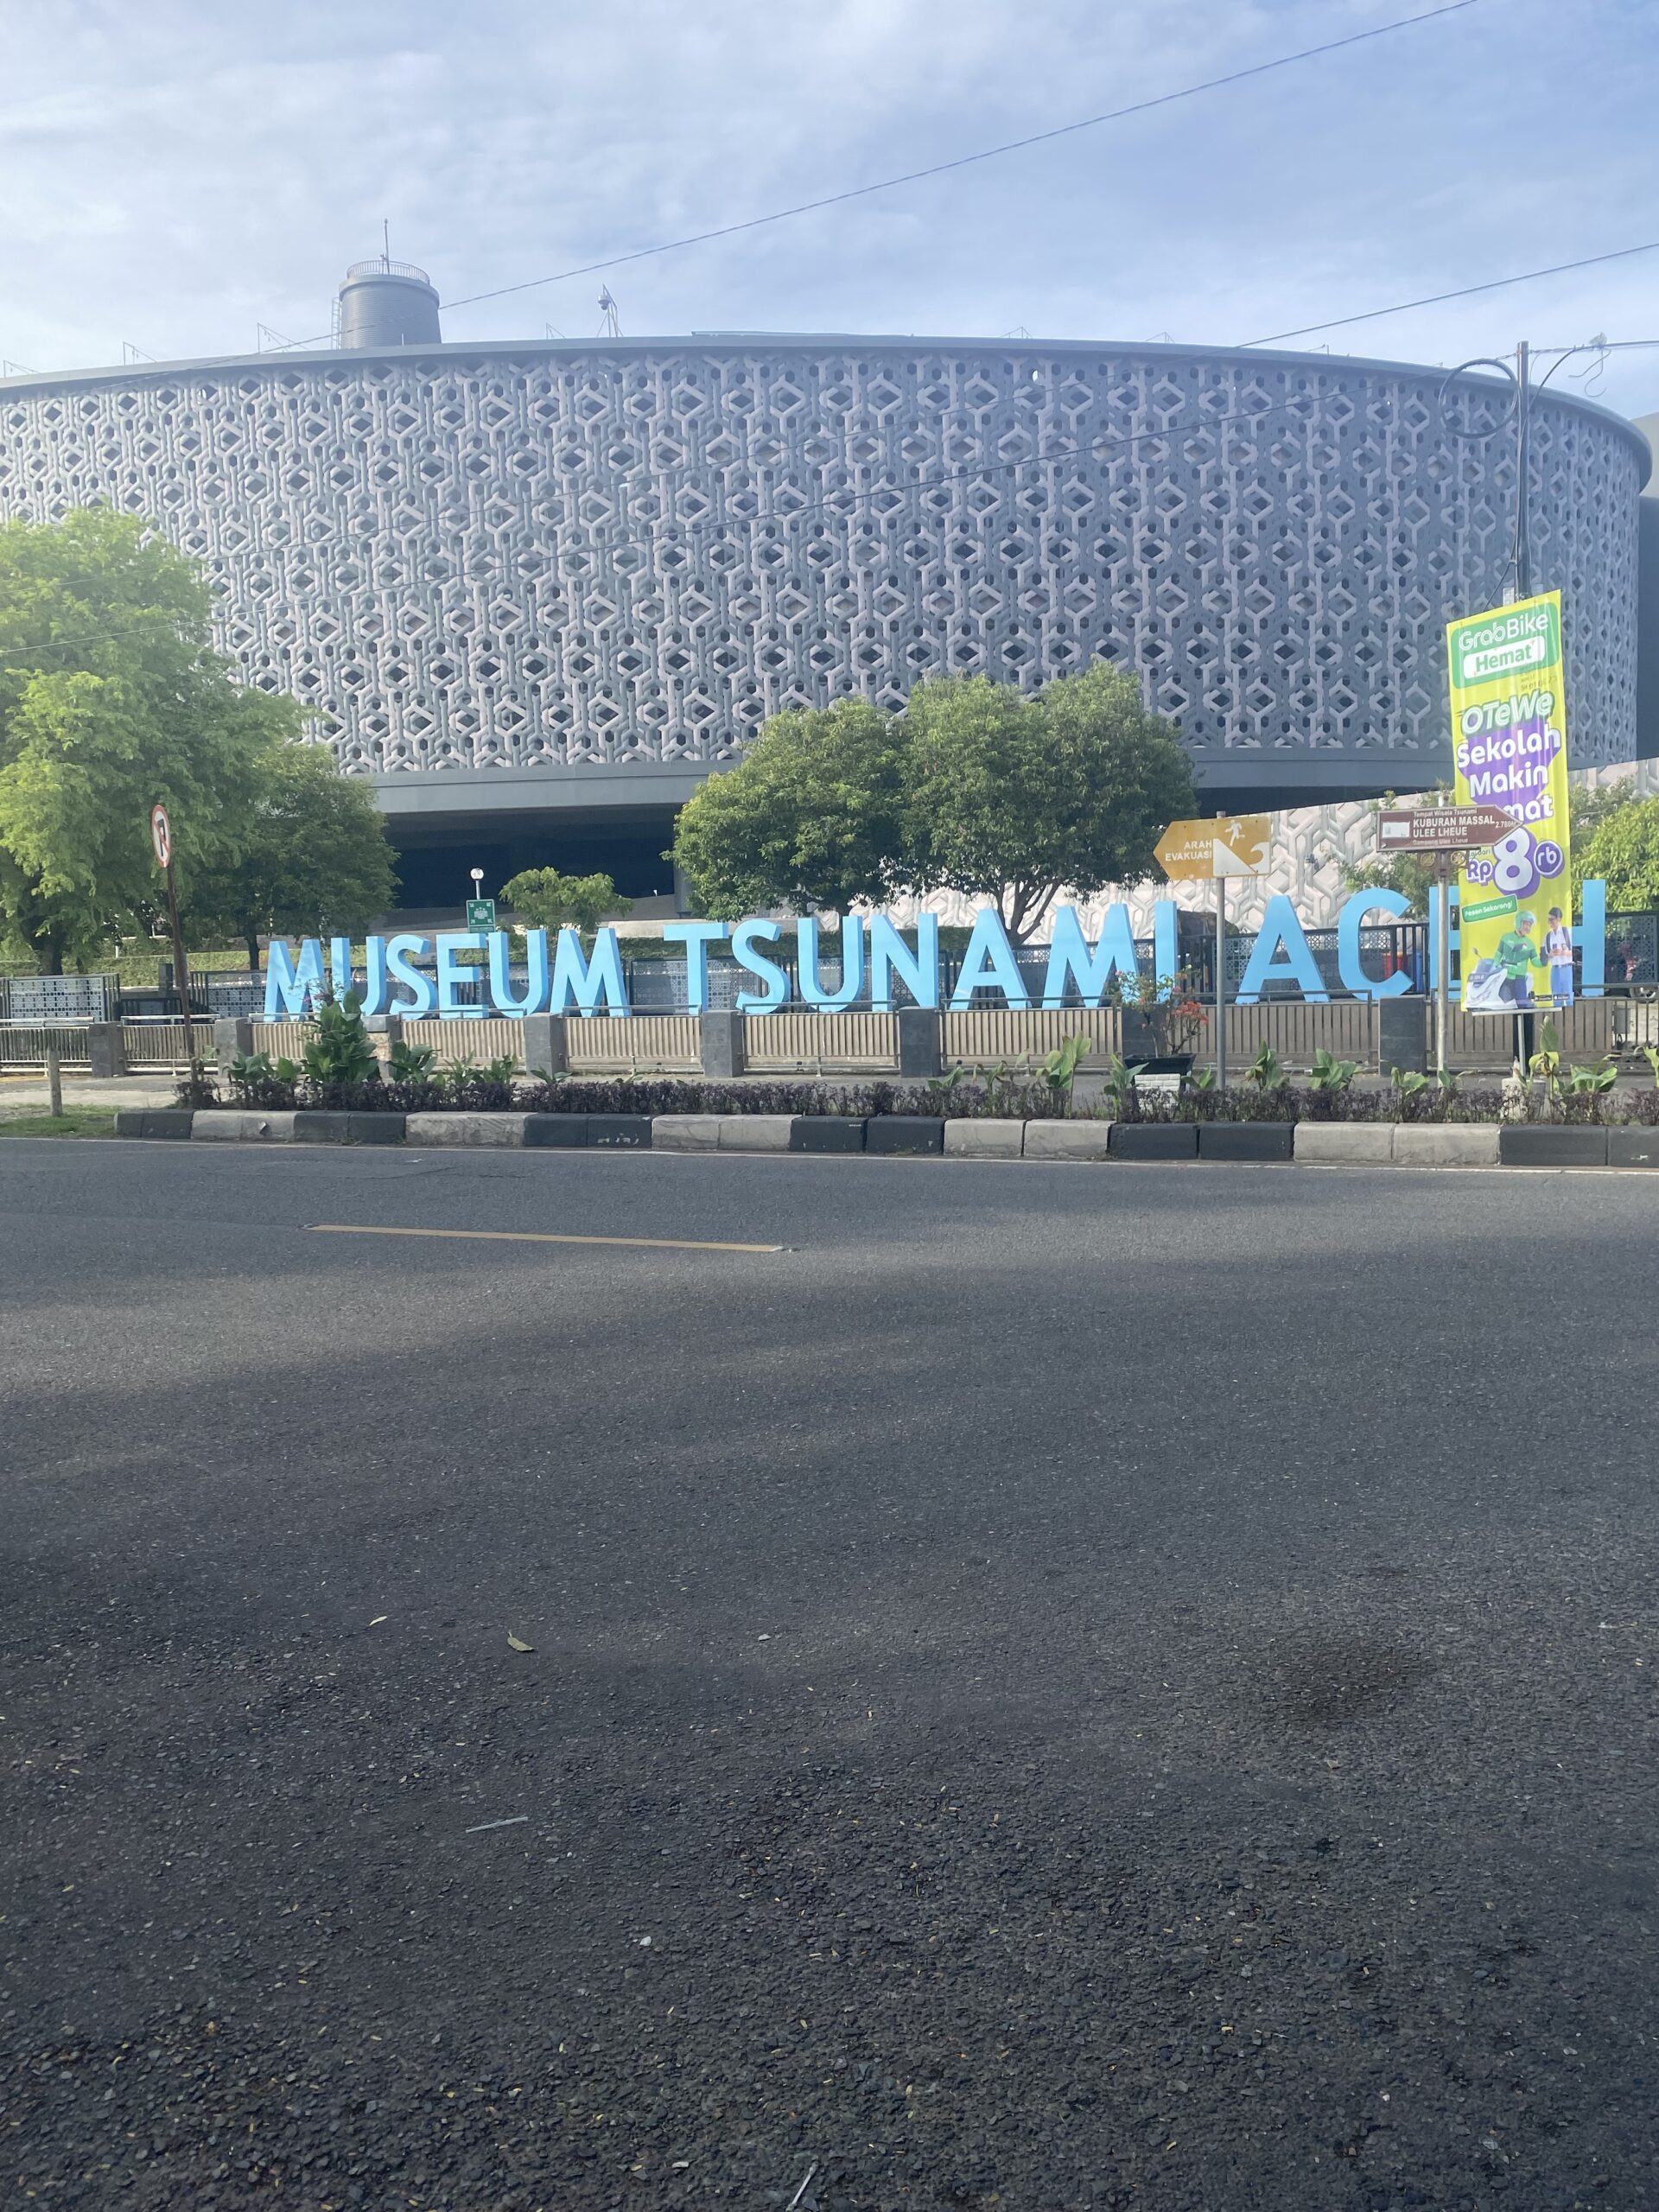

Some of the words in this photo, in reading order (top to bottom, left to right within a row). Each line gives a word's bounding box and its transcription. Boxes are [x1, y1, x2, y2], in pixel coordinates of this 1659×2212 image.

[1459, 613, 1548, 651] GrabBike
[1474, 644, 1532, 673] Hemat
[1460, 690, 1554, 735] OTeWe
[1457, 723, 1561, 768] Sekolah
[1470, 760, 1548, 798] Makin
[1413, 817, 1457, 828] KUBURAN
[1459, 815, 1496, 825] MASSAL
[1502, 794, 1554, 821] mat
[1184, 839, 1212, 850] ARAH
[1413, 828, 1436, 838] ULEE
[1438, 826, 1468, 837] LHEUE
[1165, 850, 1212, 861] EVAKUASI
[1466, 859, 1493, 882] Rp
[1493, 827, 1534, 892] 8
[1538, 847, 1557, 867] rb
[264, 927, 632, 1023] MUSEUM
[663, 900, 1178, 1014] TSUNAMI
